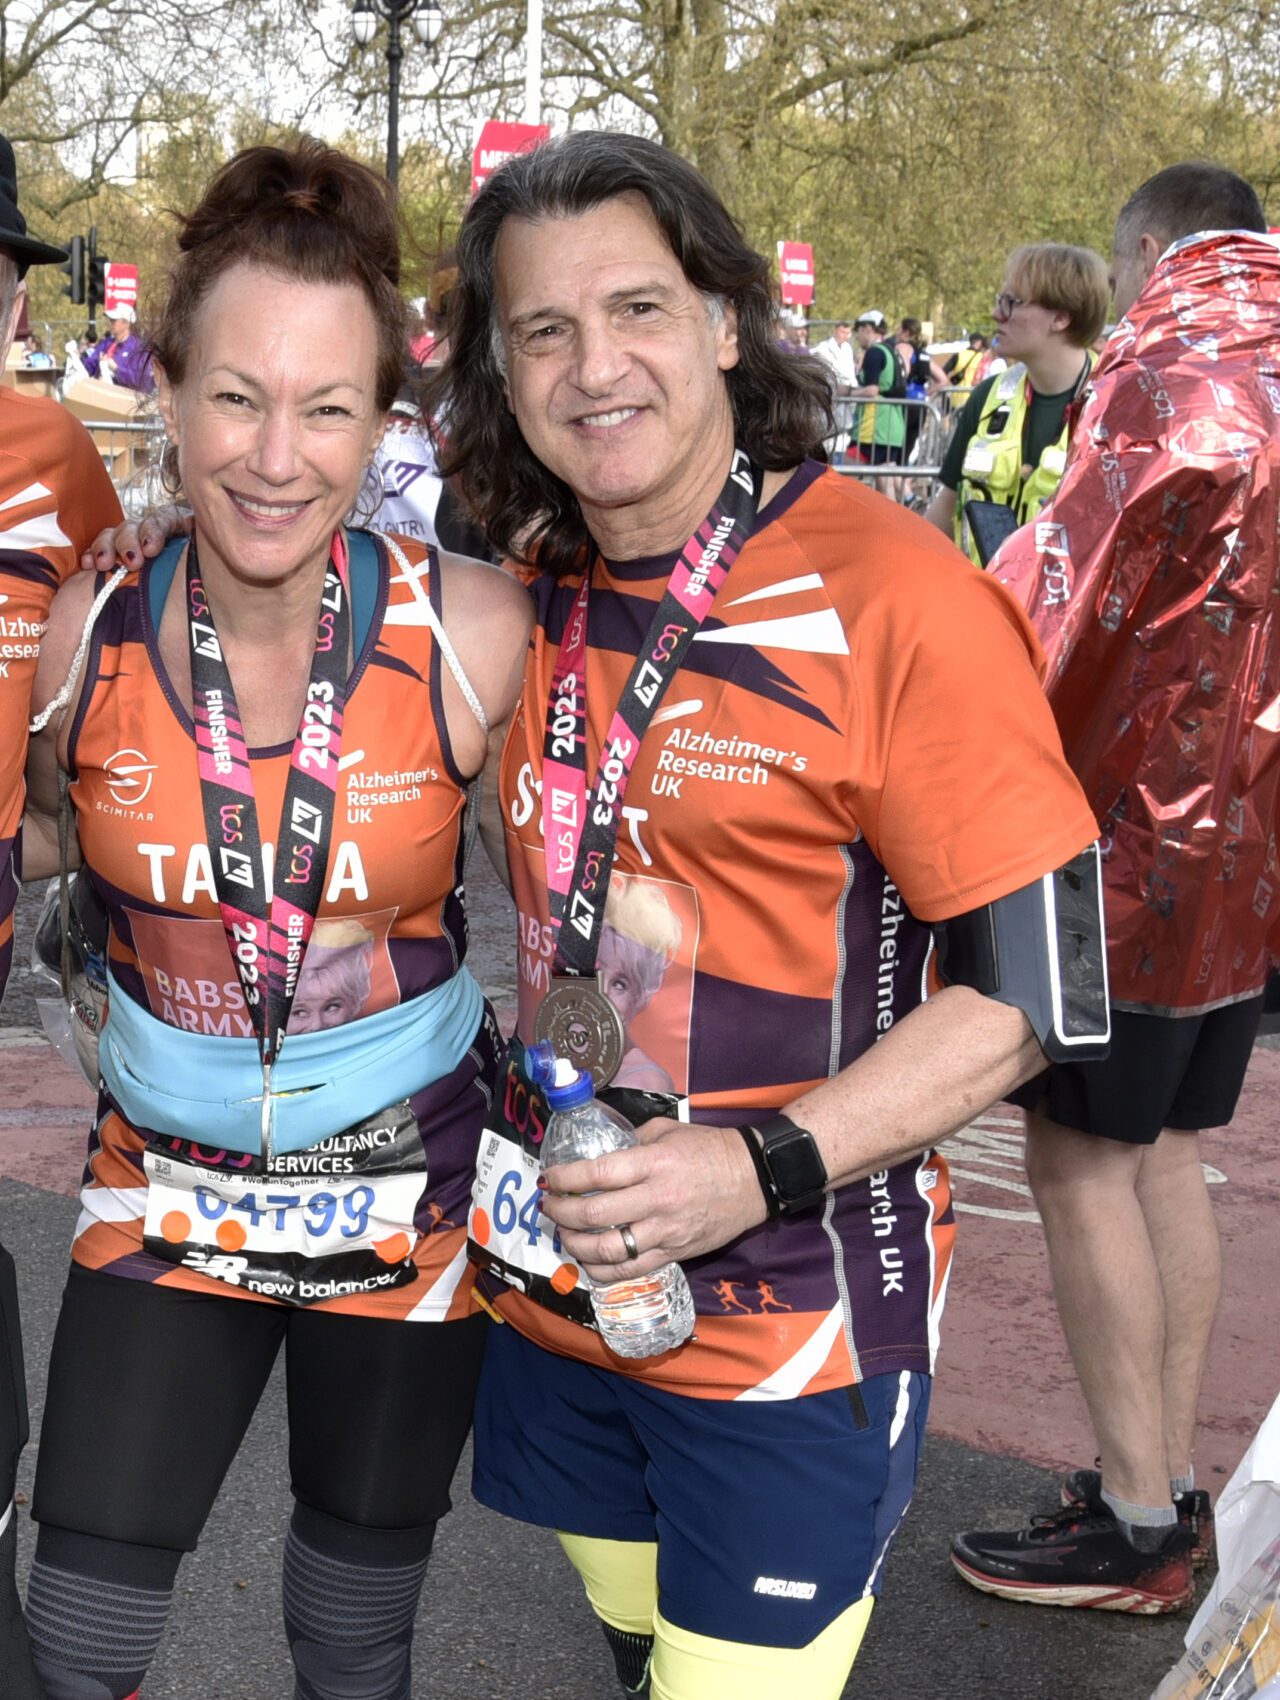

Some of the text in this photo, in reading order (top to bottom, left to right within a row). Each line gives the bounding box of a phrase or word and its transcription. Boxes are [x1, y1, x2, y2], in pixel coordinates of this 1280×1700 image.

[683, 516, 736, 597] FINISHER
[189, 578, 210, 618] tcs
[314, 612, 334, 653] tcs
[652, 623, 688, 664] tcs
[205, 689, 233, 776] FINISHER
[298, 681, 334, 769] 2023
[551, 672, 577, 759] 2023
[656, 750, 770, 786] Research
[664, 727, 809, 773] Alzheimer's
[346, 767, 439, 790] Alzheimer's
[346, 785, 422, 808] Research
[592, 737, 632, 827] 2023
[650, 772, 682, 799] UK
[96, 801, 154, 822] SCIMITAR
[220, 803, 245, 844] tcs
[346, 807, 373, 824] UK
[284, 844, 314, 885] tcs
[556, 831, 576, 874] tcs
[581, 850, 606, 892] tcs
[231, 920, 260, 1006] 2023
[285, 913, 304, 998] FINISHER
[504, 1060, 545, 1144] tcs
[869, 1168, 904, 1297] arch UK
[248, 1280, 295, 1297] new
